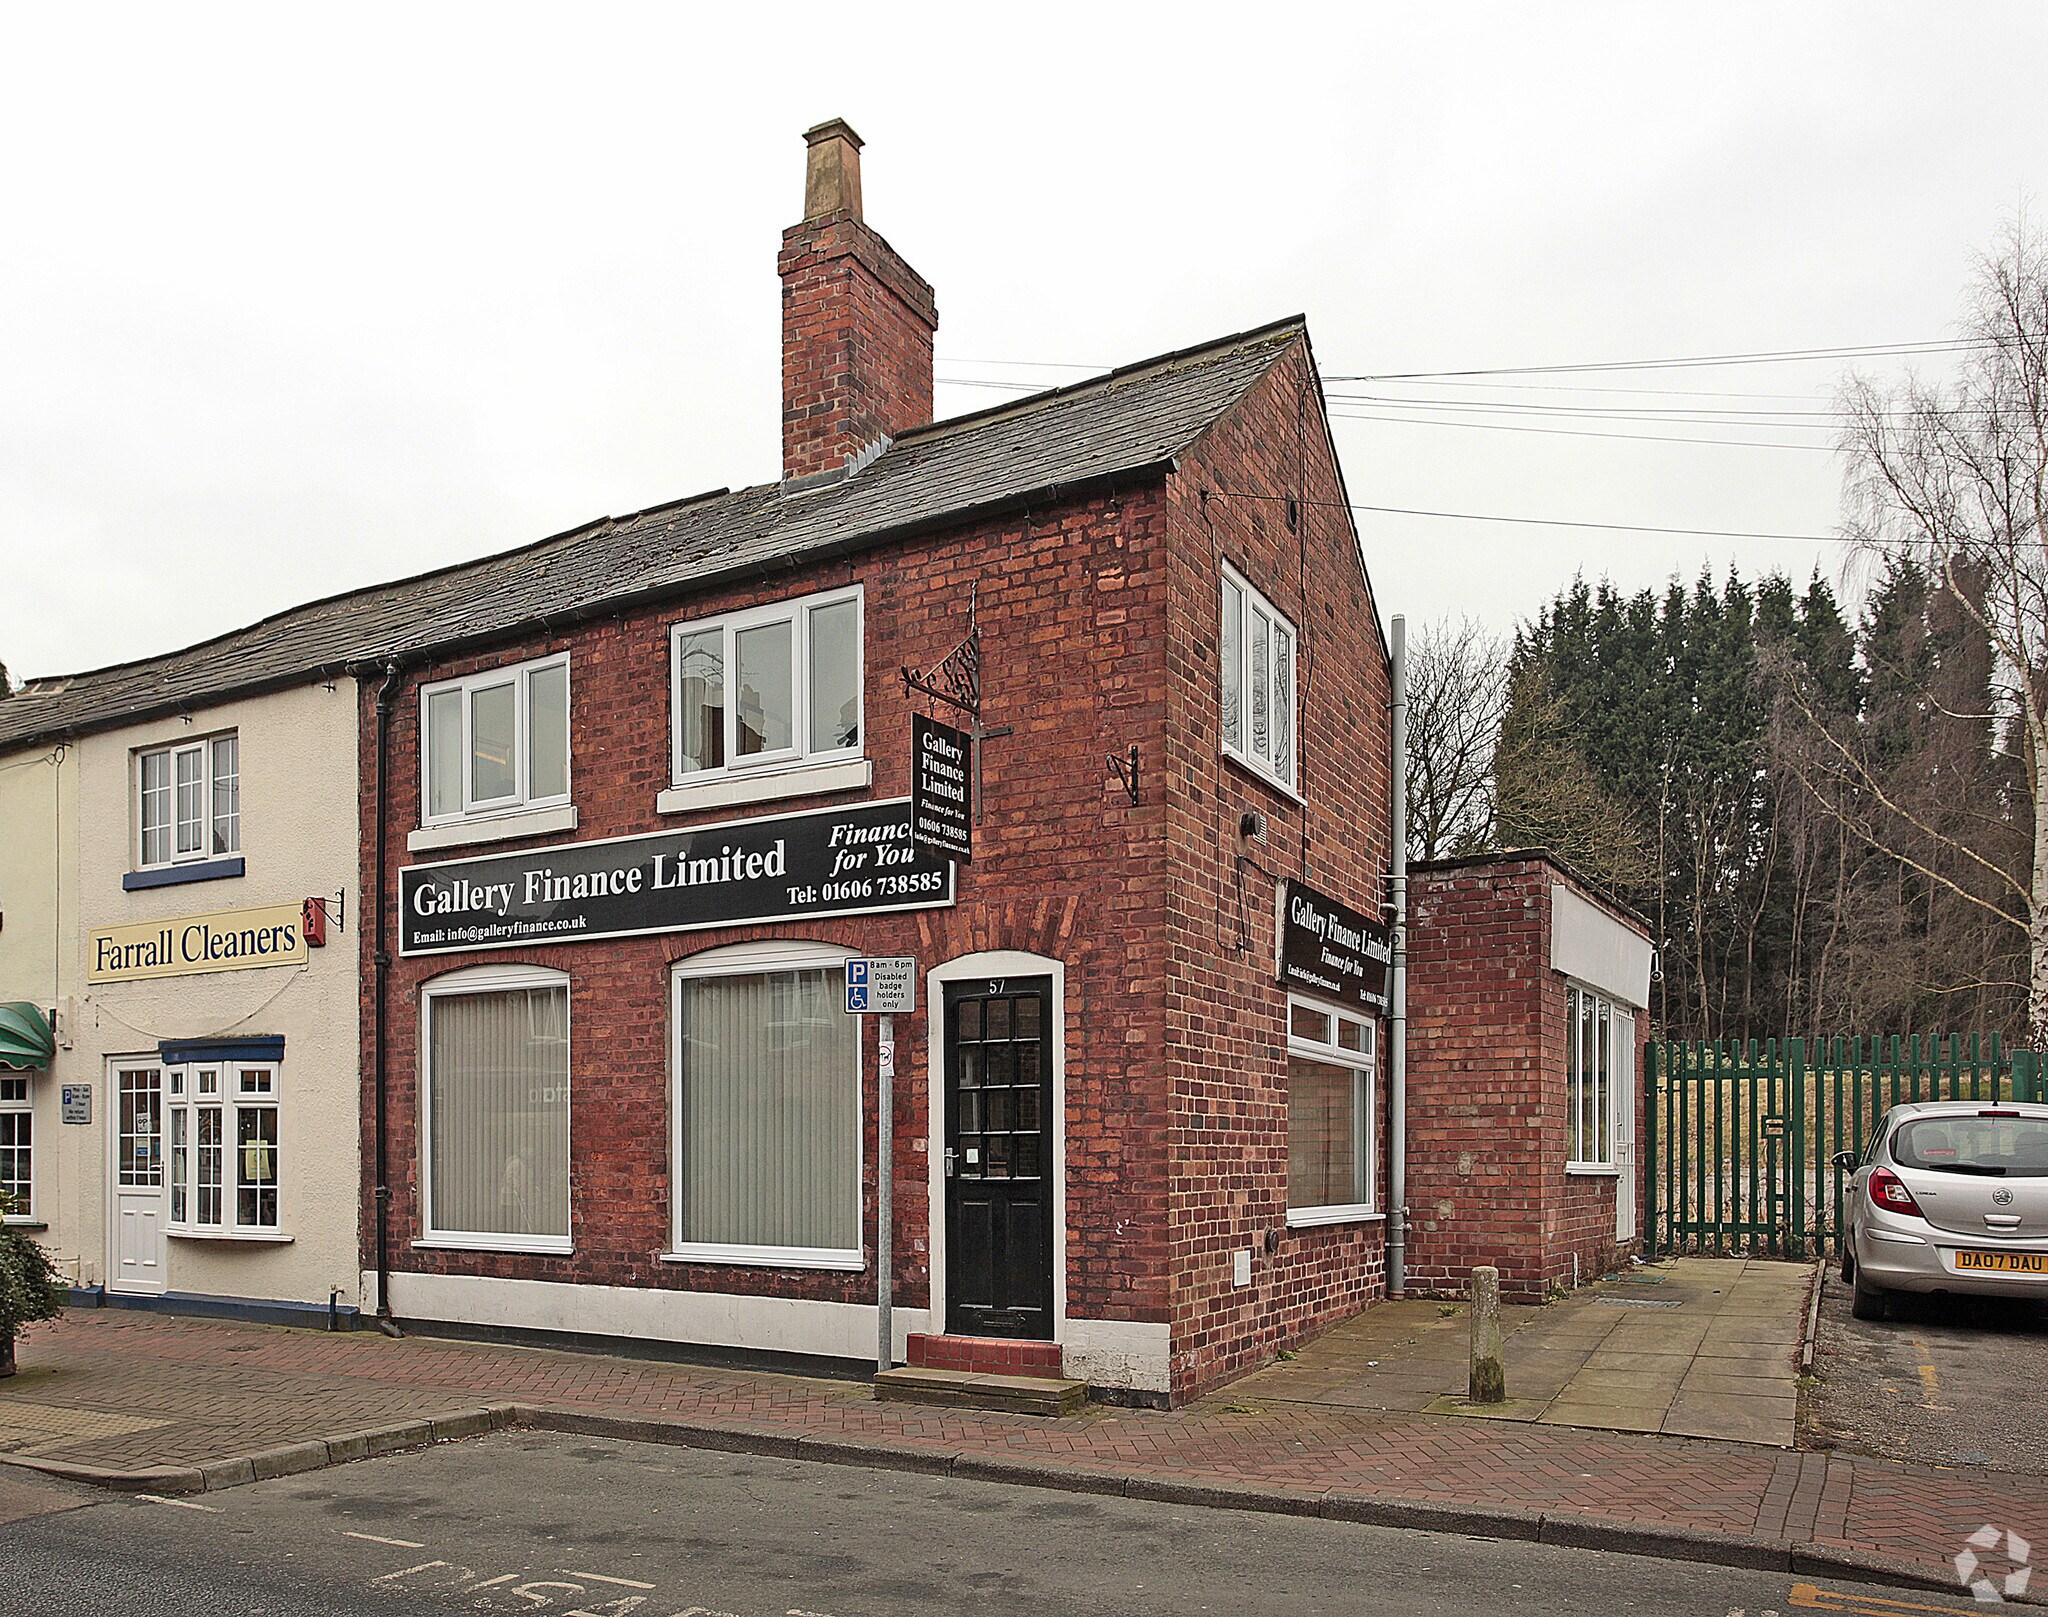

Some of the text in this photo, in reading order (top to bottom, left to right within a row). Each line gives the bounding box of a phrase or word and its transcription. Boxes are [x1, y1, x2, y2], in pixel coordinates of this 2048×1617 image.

[922, 731, 963, 765] Gallery
[921, 752, 964, 782] Finance
[921, 772, 964, 803] Limited
[920, 798, 966, 820] Finance for You
[918, 816, 968, 842] 01606 738585
[829, 845, 915, 877] for You
[413, 838, 787, 917] Gallery Finance Limited
[786, 871, 943, 905] Tel: 01606 738585
[413, 915, 587, 944] Email: info@galleryfinance.co.uk
[1291, 896, 1392, 965] Gallery Finance Limited
[95, 924, 296, 972] Farrall Cleaners
[869, 960, 888, 969] 8am
[894, 960, 913, 970] 6pm
[874, 972, 908, 981] Disabled
[876, 991, 905, 999] holders
[879, 982, 903, 991] badge
[989, 979, 1005, 994] 57
[882, 1000, 899, 1009] only
[1961, 1253, 2043, 1271] DA07 DAU
